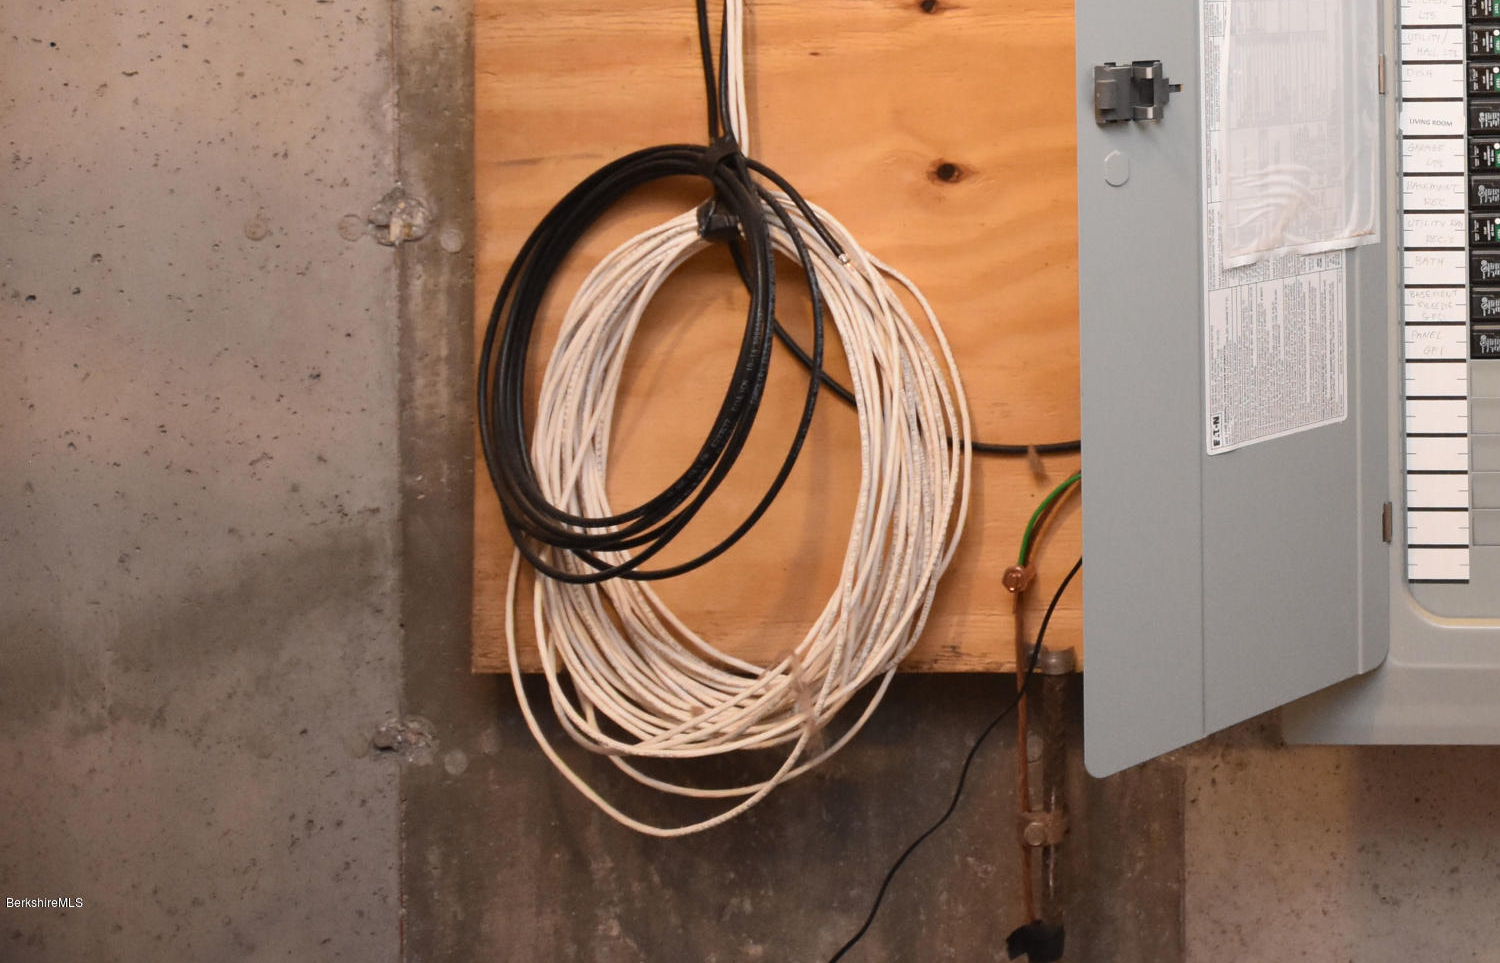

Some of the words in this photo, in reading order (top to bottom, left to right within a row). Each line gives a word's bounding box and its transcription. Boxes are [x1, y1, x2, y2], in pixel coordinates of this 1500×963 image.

[1409, 118, 1431, 126] LIVING
[1431, 119, 1453, 127] ROOM
[1407, 218, 1446, 228] UTILITY
[1415, 255, 1445, 266] BATH
[1408, 289, 1457, 299] BASEMENT
[1411, 329, 1442, 340] PANEL
